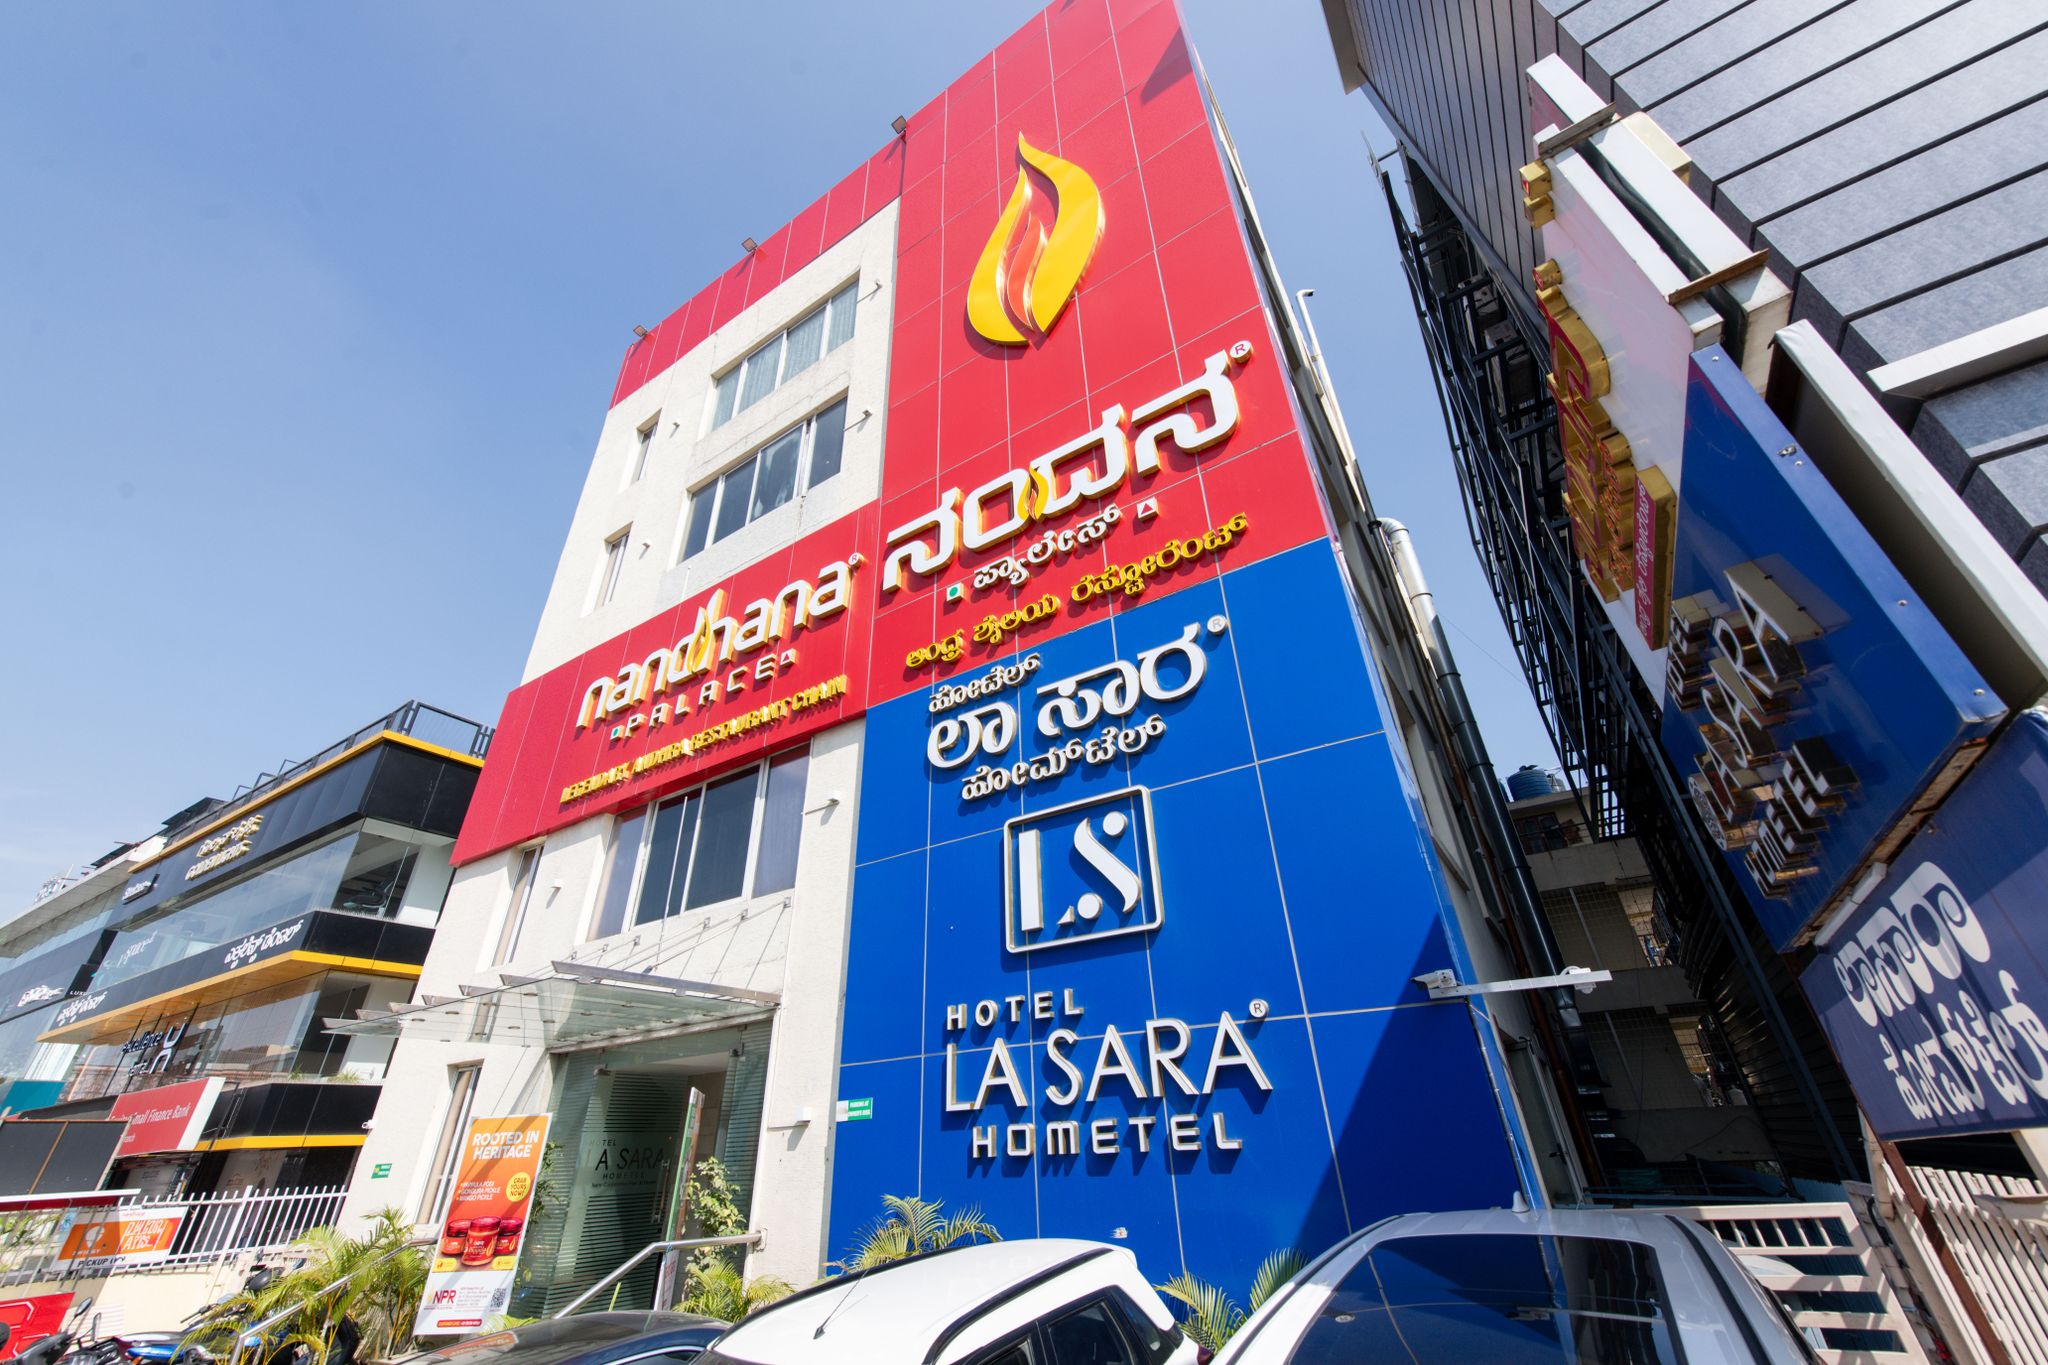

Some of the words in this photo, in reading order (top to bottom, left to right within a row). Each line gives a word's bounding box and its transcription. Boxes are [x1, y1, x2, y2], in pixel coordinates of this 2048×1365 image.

[882, 350, 1241, 591] ನಂದನ
[973, 504, 1122, 586] ಪ್ಯಾಲೇಸ್
[576, 588, 850, 728] nandhana
[928, 652, 1041, 713] ಹೋಟೆಲ್
[625, 653, 779, 738] PALACE
[927, 701, 1018, 769] ಲಾ
[1036, 622, 1208, 738] ಸಾರ
[560, 761, 631, 804] LEGENDARY
[631, 738, 693, 774] ANDHRA
[690, 697, 791, 752] RESTAURANT
[791, 674, 847, 712] CHAIN
[946, 988, 1084, 1032] HOTEL
[946, 1037, 1028, 1112] LA
[1045, 1011, 1274, 1107] SARA
[149, 1105, 174, 1122] Finance
[172, 1102, 192, 1119] Bank
[472, 1131, 524, 1146] ROOTED
[526, 1130, 540, 1144] IN
[972, 1112, 1243, 1159] HOMETEL
[473, 1145, 532, 1159] HERITAGE
[432, 1289, 457, 1304] NPR
